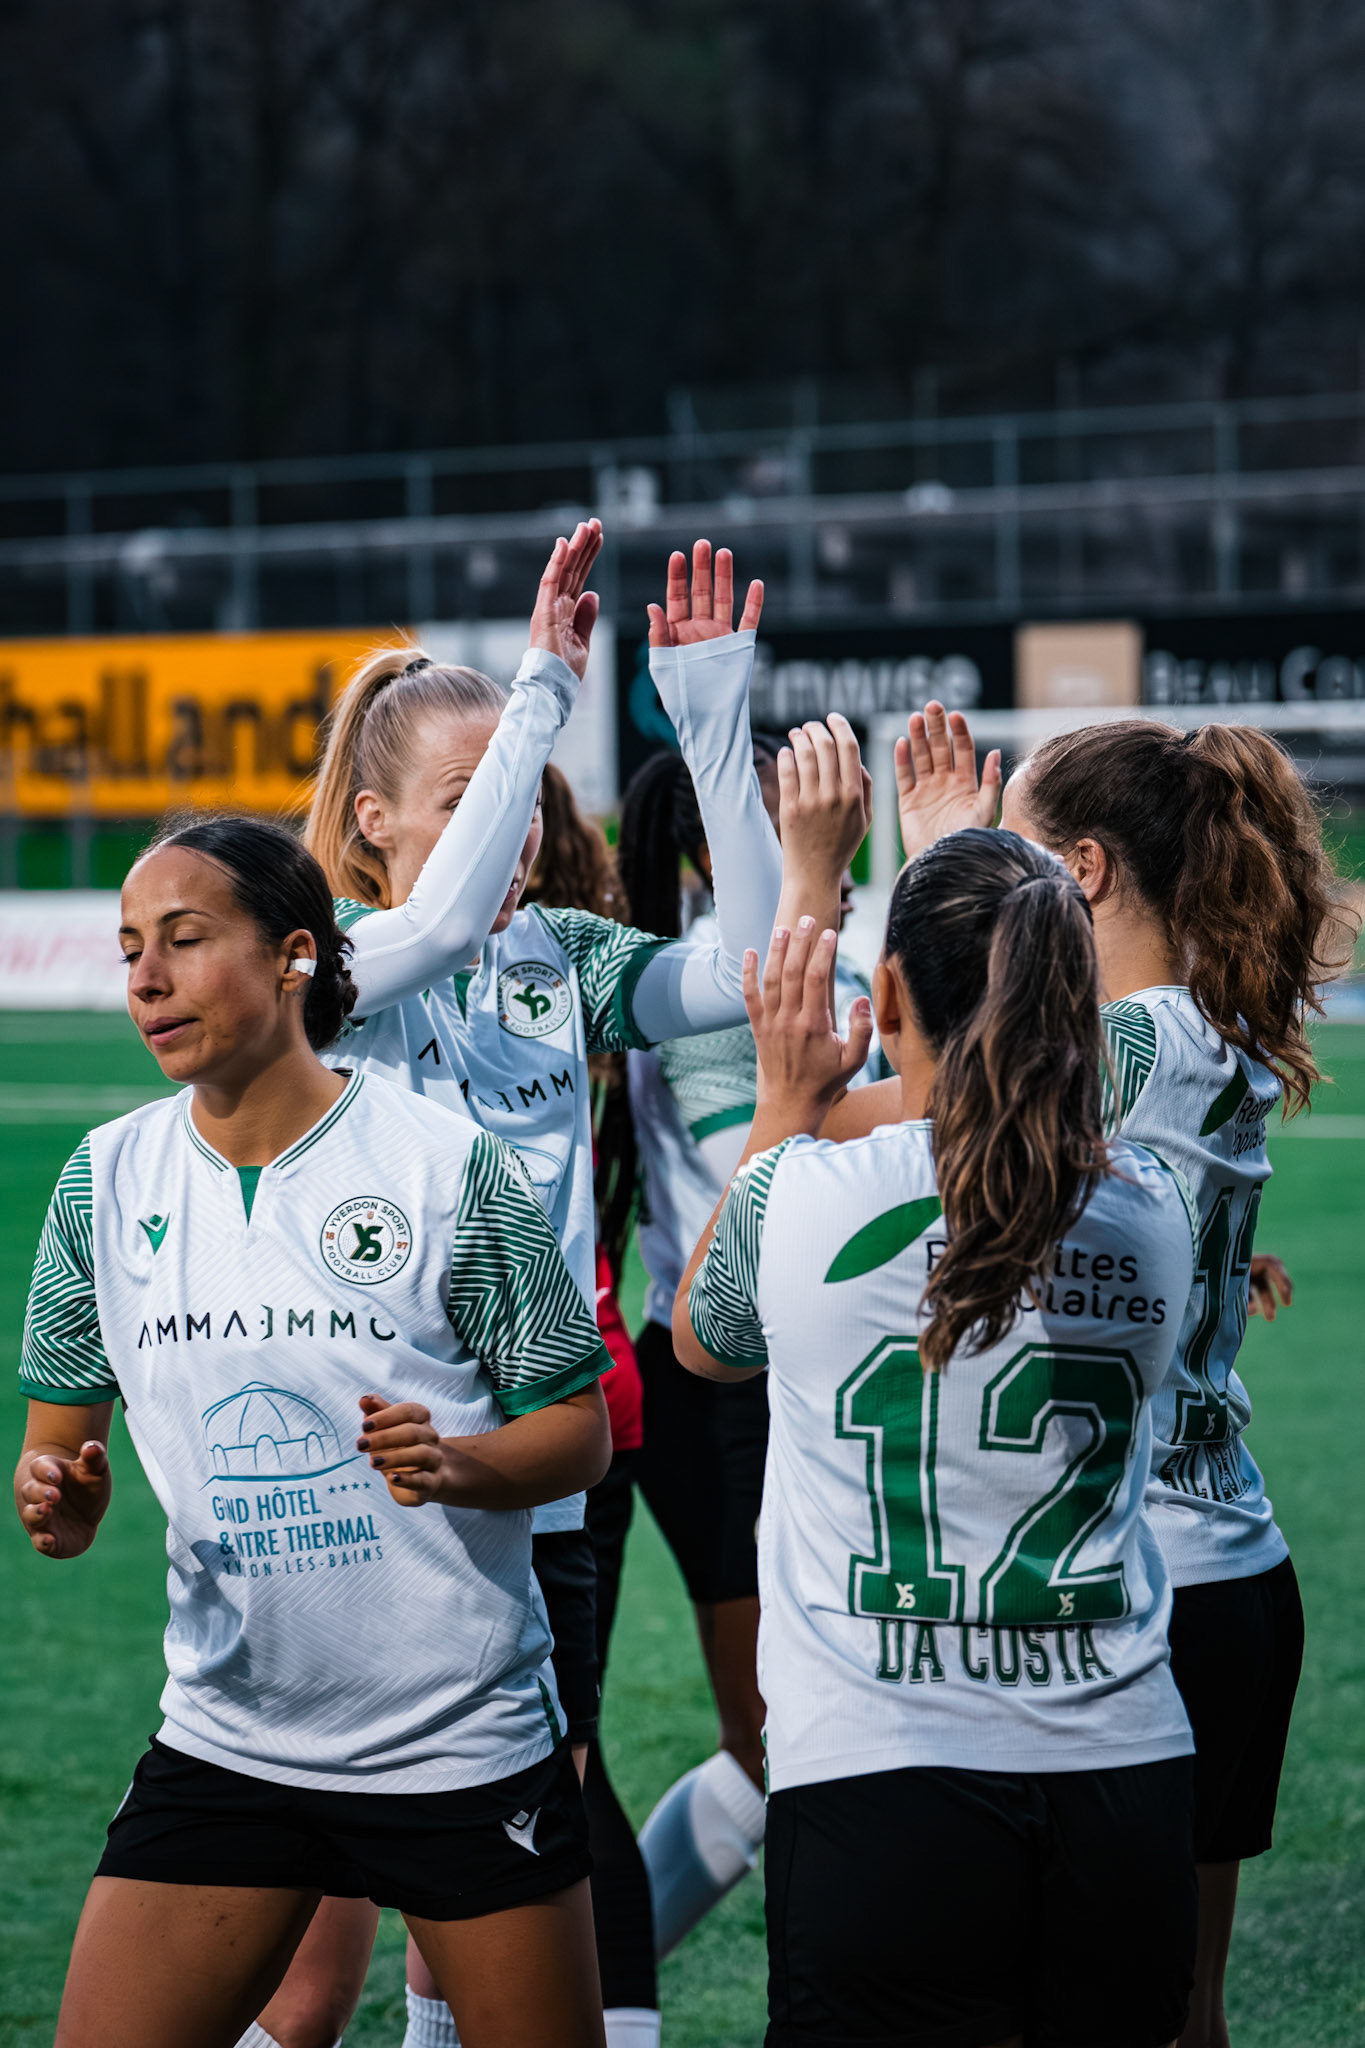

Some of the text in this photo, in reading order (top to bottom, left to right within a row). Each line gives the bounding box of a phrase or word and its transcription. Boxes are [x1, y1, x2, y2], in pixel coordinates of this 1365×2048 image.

[521, 966, 554, 979] SPORT
[328, 1201, 407, 1236] YVERDON SPORT
[327, 1245, 402, 1279] FOOTBALL CLUB
[926, 1240, 1138, 1283] Rites
[835, 1336, 1144, 1625] 12
[256, 1486, 322, 1521] HÔTEL
[219, 1531, 236, 1556] &
[284, 1514, 380, 1553] THERMAL
[876, 1618, 1117, 1687] DA COSTA
